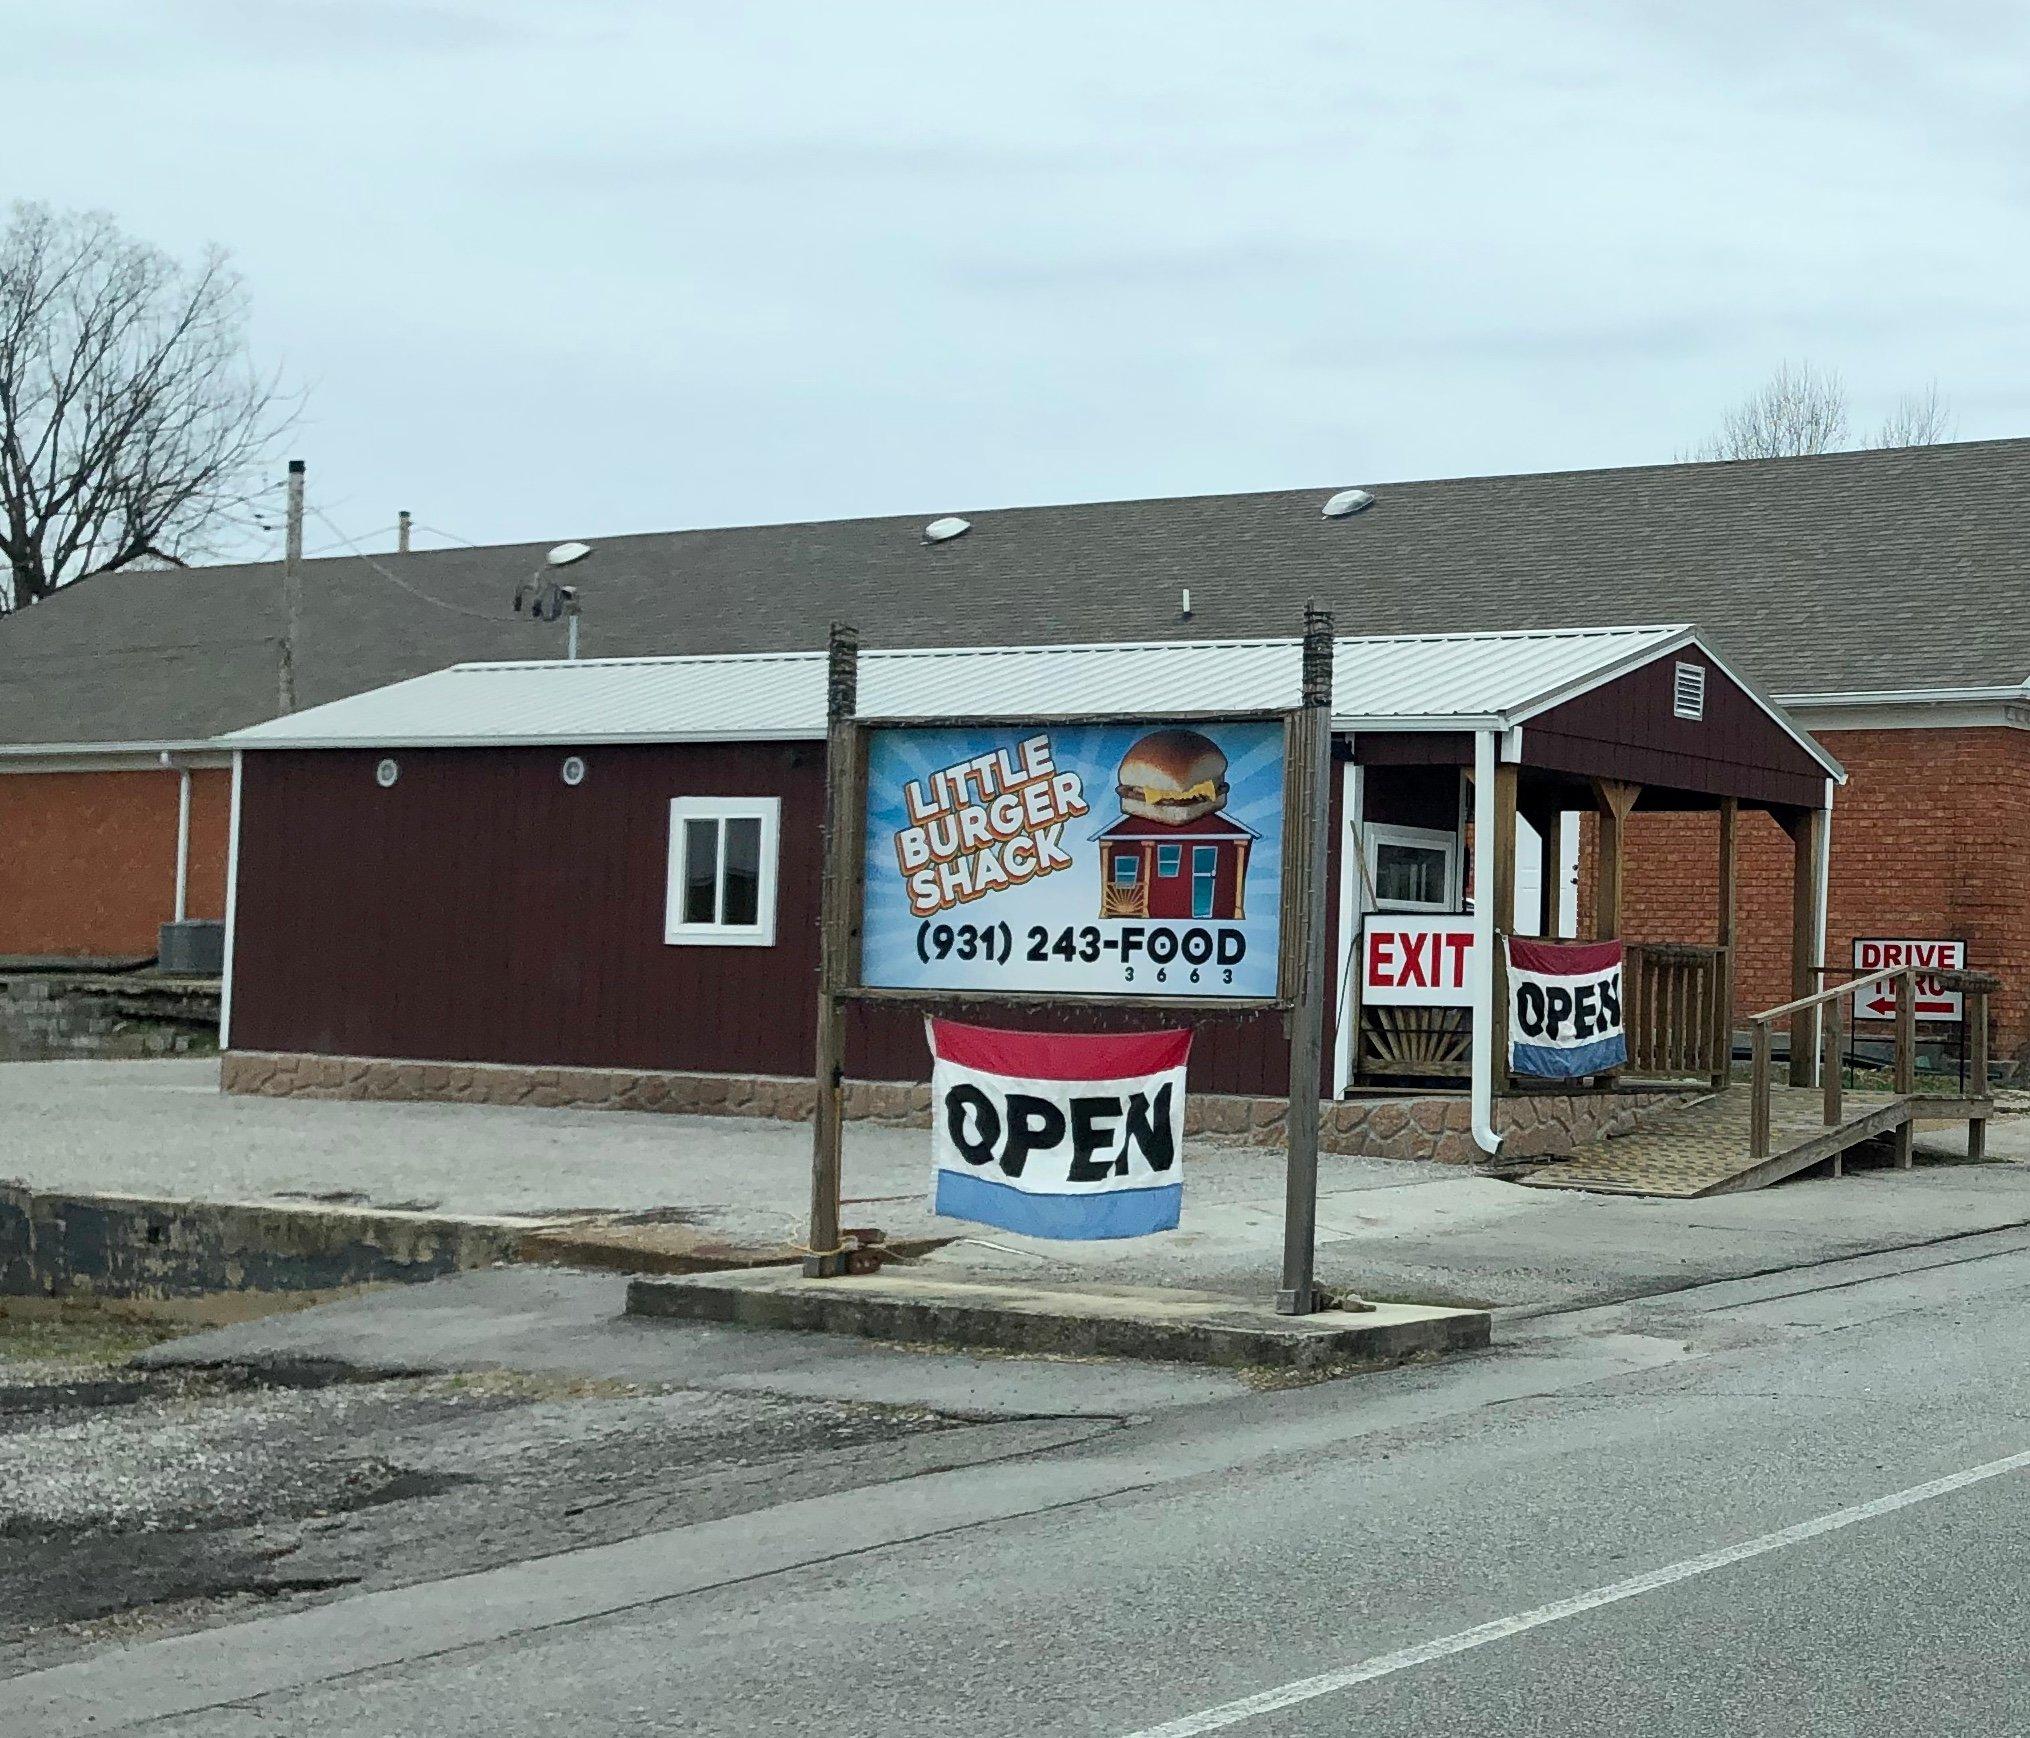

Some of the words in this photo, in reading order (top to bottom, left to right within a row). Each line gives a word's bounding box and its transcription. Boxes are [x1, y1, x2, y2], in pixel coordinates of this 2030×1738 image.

[904, 732, 1056, 823] LITTLE
[896, 771, 1089, 874] BURGER
[906, 825, 1073, 915] SHACK
[916, 919, 1013, 966] (931)
[1026, 925, 1247, 966] 243-FOOD
[1368, 932, 1475, 988] EXIT
[1861, 943, 1956, 970] DRIVE
[1516, 972, 1621, 1042] OPEN
[945, 1082, 1175, 1182] OPEN
